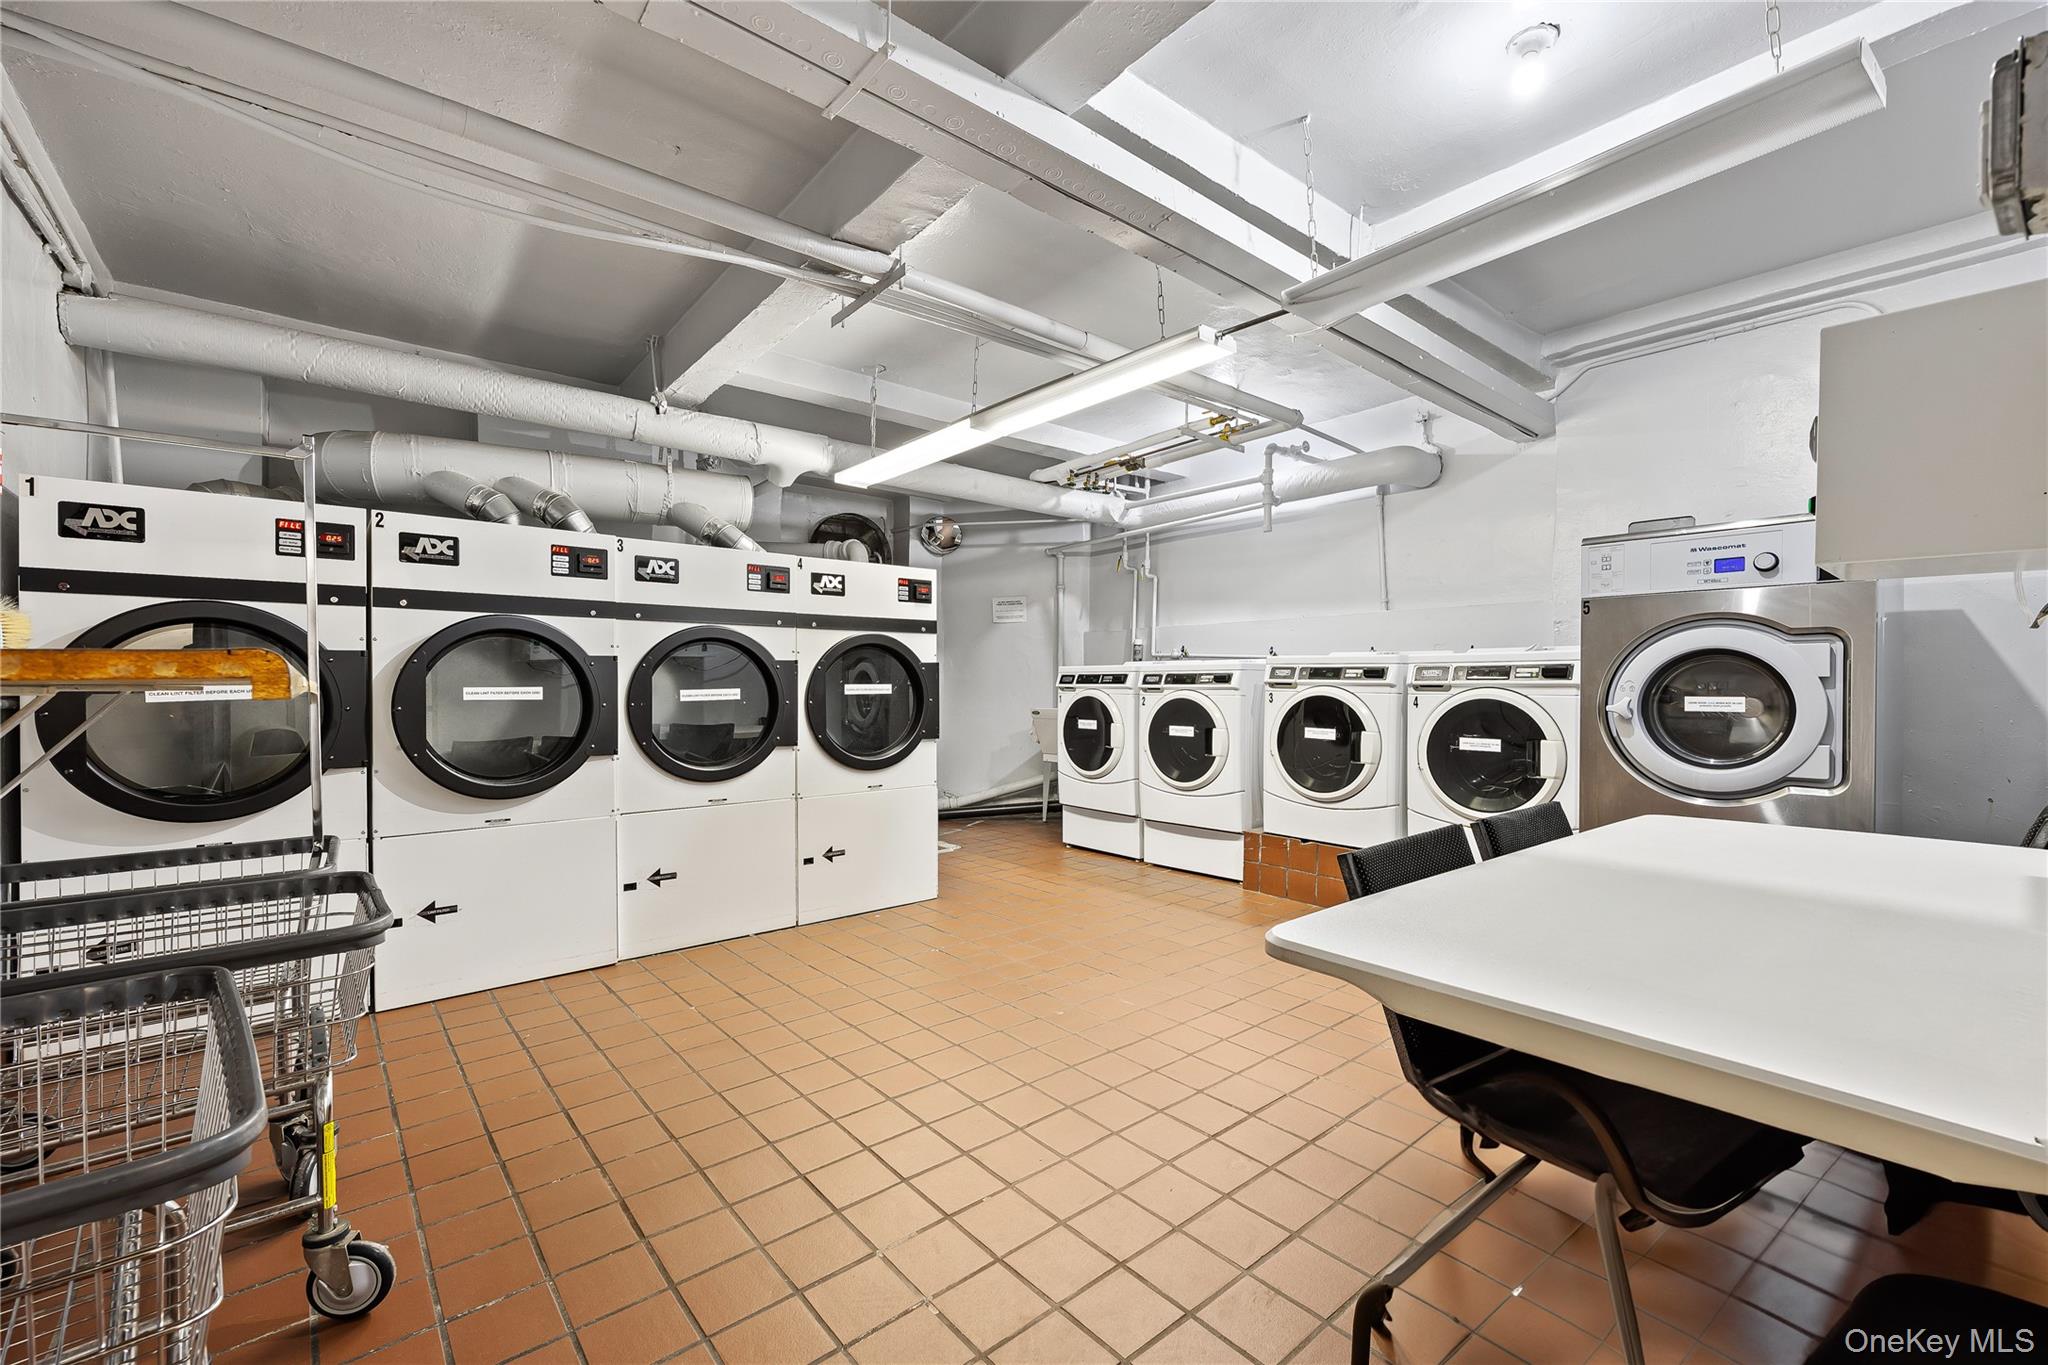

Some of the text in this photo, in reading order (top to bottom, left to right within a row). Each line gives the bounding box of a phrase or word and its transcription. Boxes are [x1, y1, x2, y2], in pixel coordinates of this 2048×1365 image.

[25, 477, 35, 496] 1
[81, 507, 137, 530] ADC
[375, 512, 384, 528] 2
[414, 537, 454, 556] ADC
[617, 539, 624, 552] 3
[1698, 544, 1747, 552] Wascomat
[646, 559, 675, 575] ADC
[797, 557, 803, 570] 4
[820, 575, 842, 588] ADC
[1582, 600, 1591, 615] 5
[1142, 696, 1146, 706] 2
[1268, 692, 1274, 703] 3
[1412, 696, 1419, 708] 4
